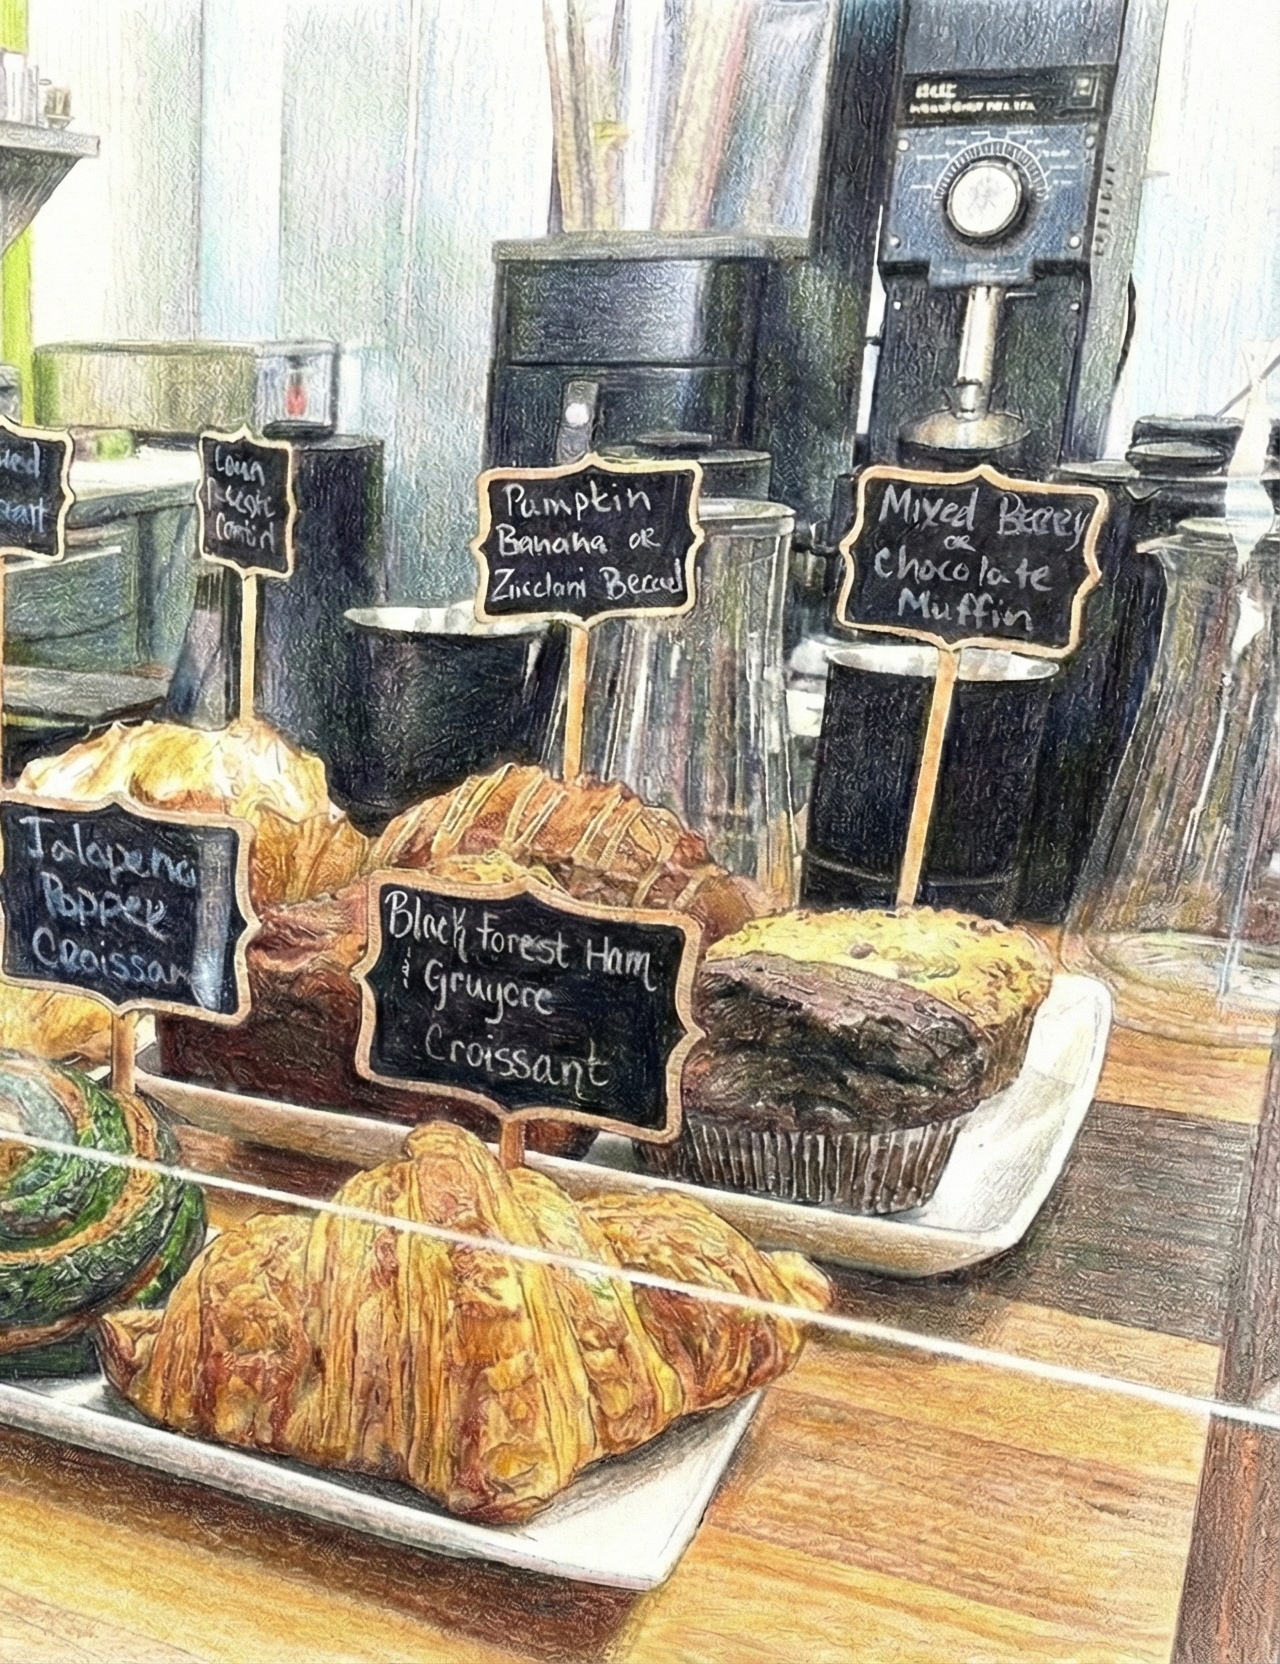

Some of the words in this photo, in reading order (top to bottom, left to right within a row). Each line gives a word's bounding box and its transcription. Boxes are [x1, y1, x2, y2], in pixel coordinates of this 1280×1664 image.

[879, 484, 980, 531] Mixed
[495, 523, 608, 557] Banana
[874, 545, 1053, 592] Chocolate
[475, 911, 568, 969] Forest
[586, 936, 657, 992] Ham
[425, 1023, 609, 1101] Croissant
